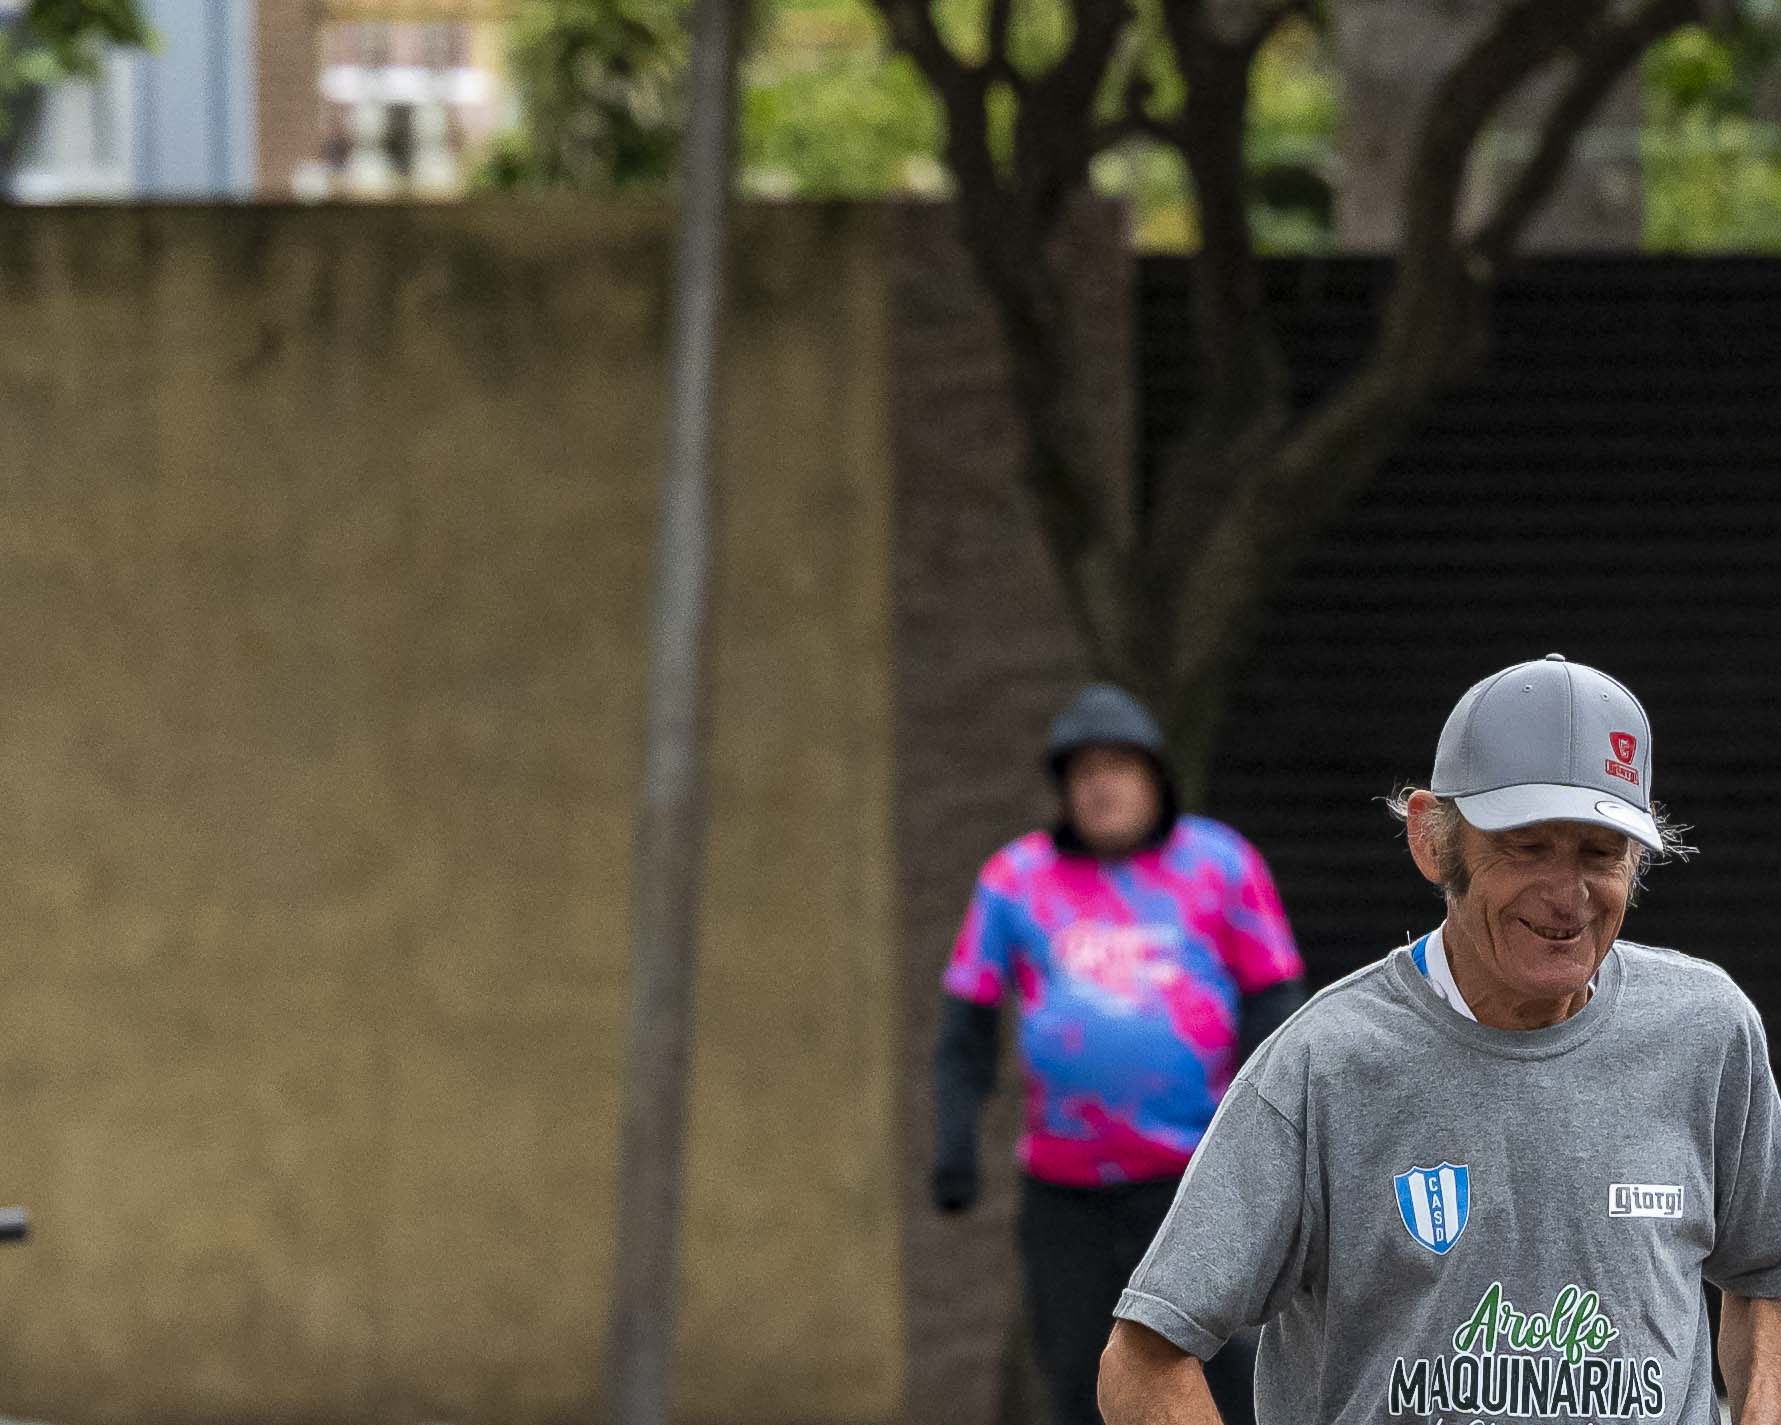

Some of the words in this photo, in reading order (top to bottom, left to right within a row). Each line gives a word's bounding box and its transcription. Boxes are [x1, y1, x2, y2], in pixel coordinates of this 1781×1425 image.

[1428, 1177, 1445, 1242] CASD
[1453, 1281, 1619, 1366] Arolfo
[1389, 1355, 1666, 1418] MAQUINARIAS
